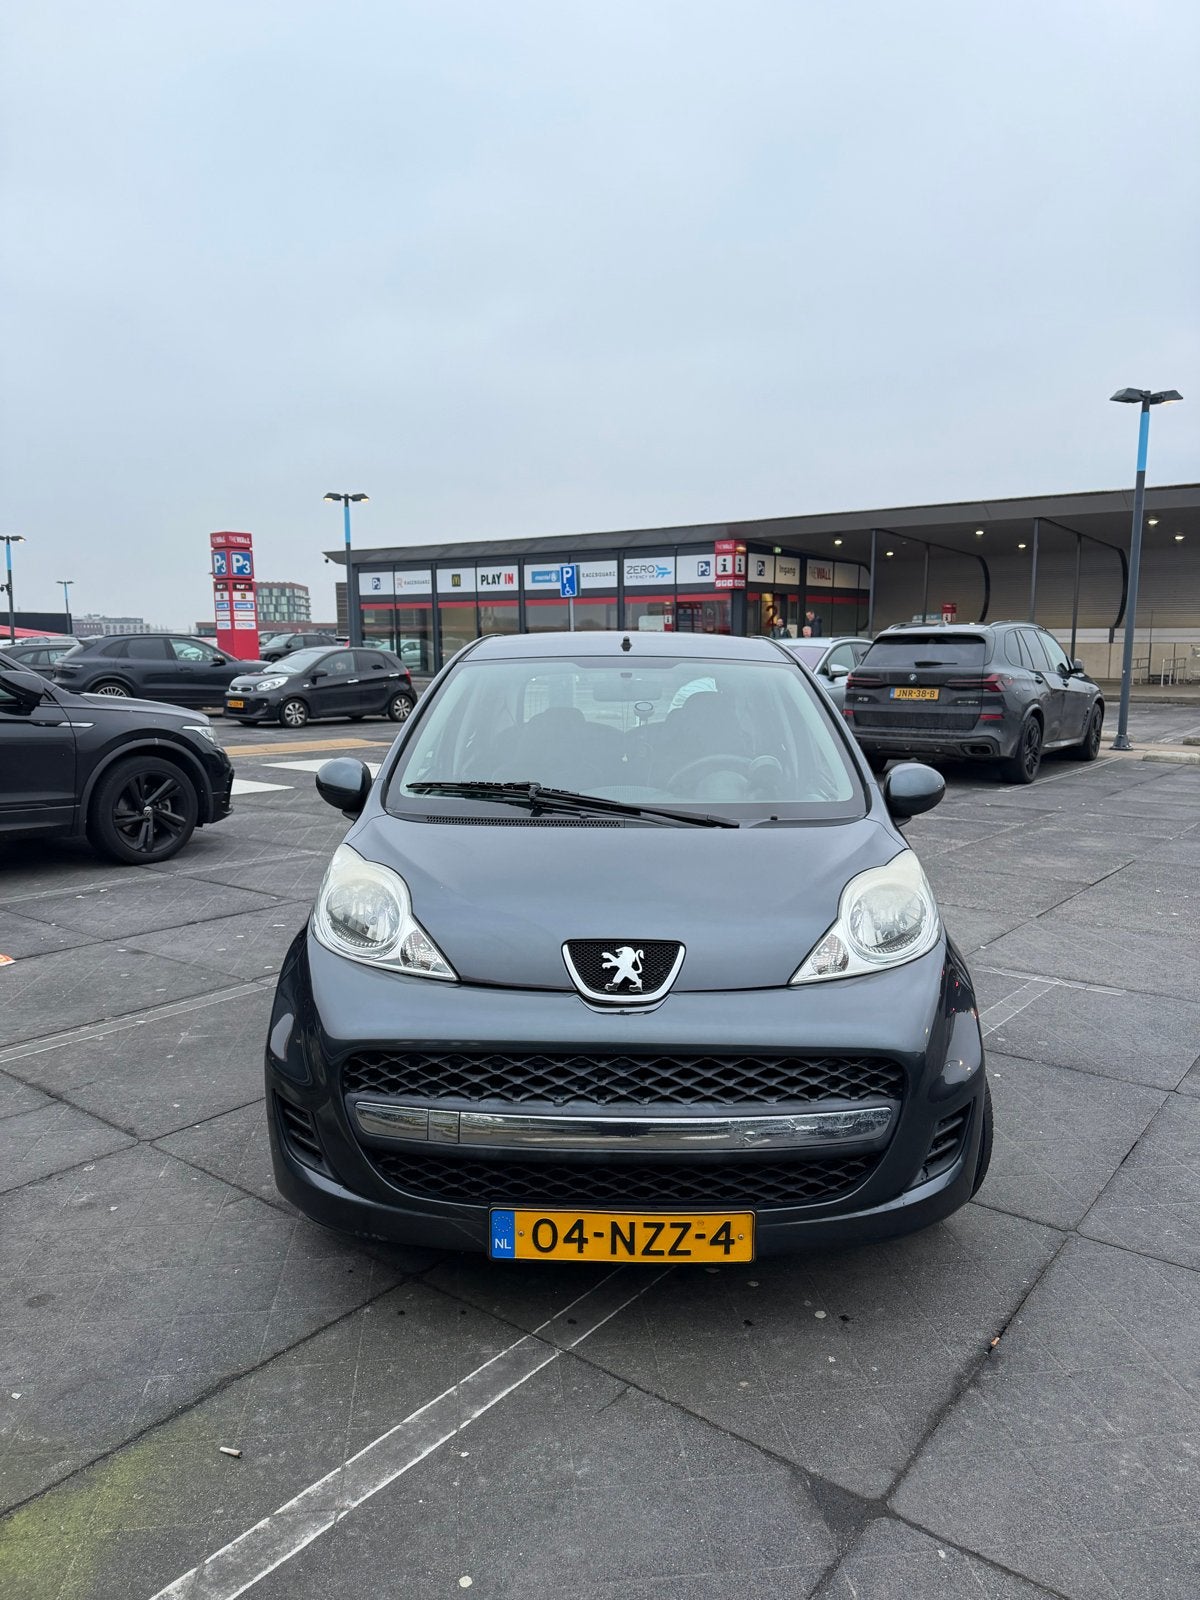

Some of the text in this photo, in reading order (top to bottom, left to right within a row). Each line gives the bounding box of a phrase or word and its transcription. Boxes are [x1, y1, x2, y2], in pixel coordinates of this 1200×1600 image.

[563, 567, 572, 584] P
[626, 565, 655, 574] ZERO
[779, 564, 796, 576] Ingang
[481, 572, 513, 585] PLAY IN
[897, 689, 935, 698] JNR-38-B
[531, 1218, 736, 1257] 04-NZZ-4
[494, 1238, 512, 1250] NL
